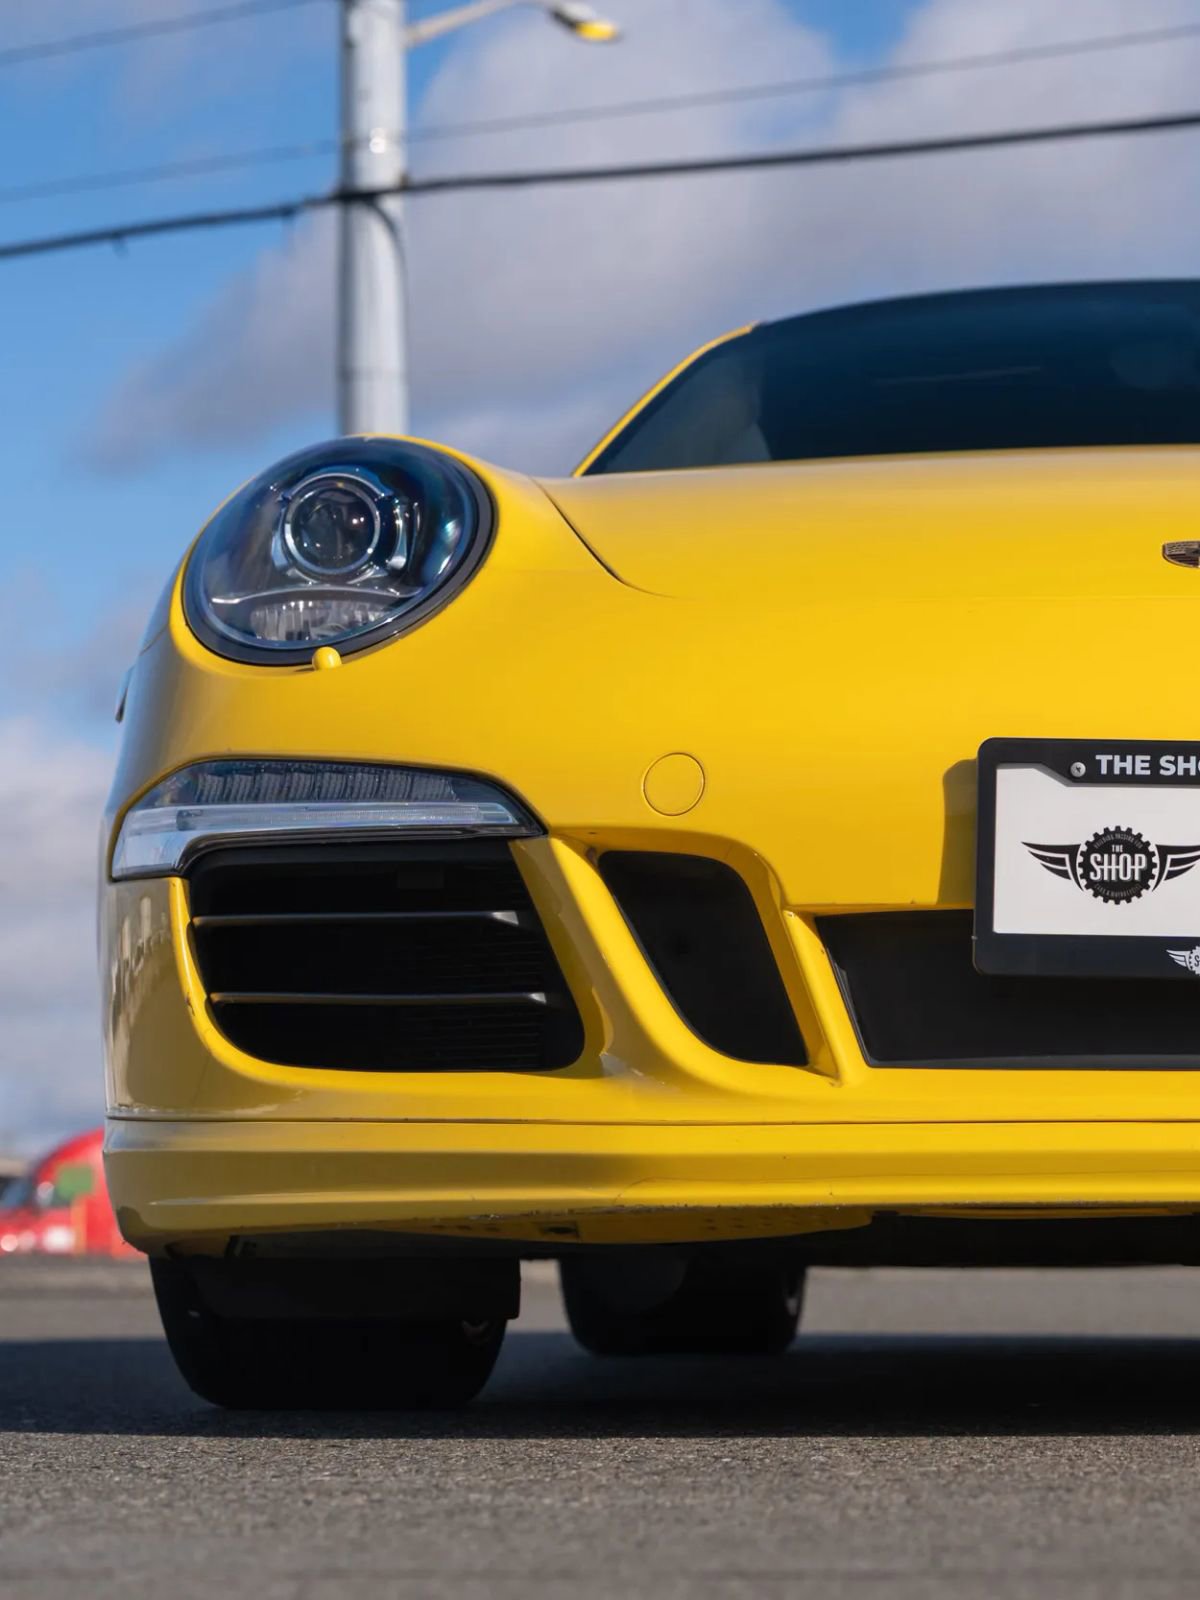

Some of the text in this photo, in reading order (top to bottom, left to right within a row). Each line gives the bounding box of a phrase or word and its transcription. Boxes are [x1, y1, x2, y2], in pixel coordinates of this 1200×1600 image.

[1095, 754, 1151, 776] THE
[1111, 844, 1123, 853] THE
[1089, 852, 1148, 882] SHOP
